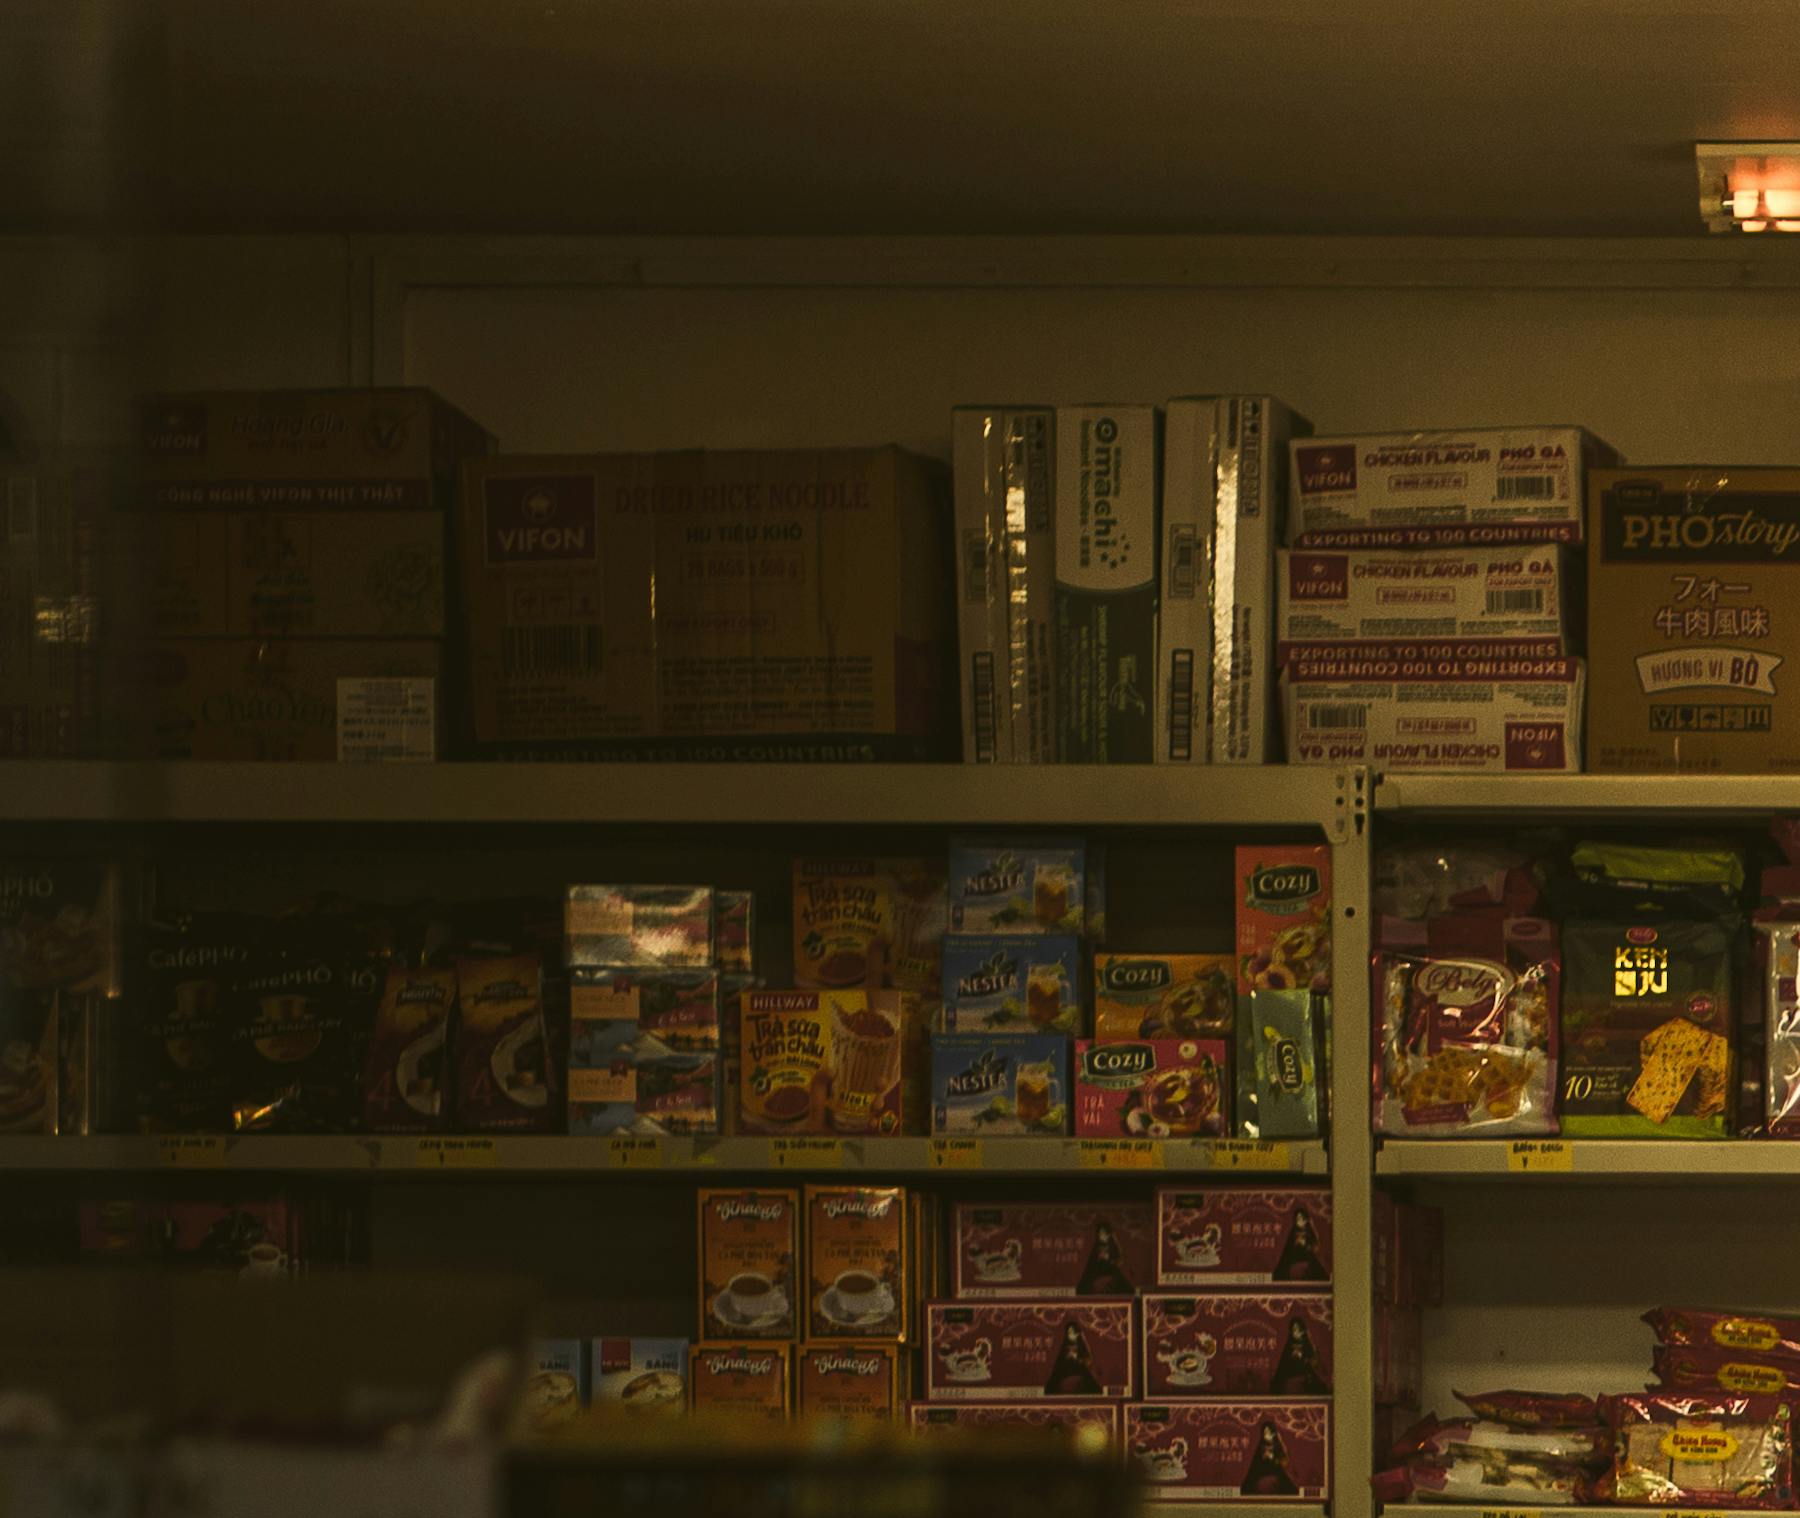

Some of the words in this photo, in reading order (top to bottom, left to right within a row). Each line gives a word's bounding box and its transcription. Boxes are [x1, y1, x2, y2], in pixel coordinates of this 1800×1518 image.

[1363, 451, 1424, 469] CHICKEN
[614, 483, 697, 515] DRIED
[701, 481, 762, 514] RICE
[768, 480, 870, 511] NOODLE
[497, 525, 587, 554] VIFON
[1302, 531, 1406, 547] EXPORTING
[1408, 529, 1431, 544] TO
[1435, 528, 1466, 543] 100
[1468, 526, 1571, 542] COUNTRIES
[1353, 563, 1411, 580] CHICKEN
[1674, 574, 1750, 601] フォー
[1656, 606, 1769, 637] 牛肉風味
[1289, 646, 1391, 662] EXPORTING
[1395, 646, 1418, 660] TO
[1422, 645, 1452, 660] 100
[1455, 643, 1558, 659] COUNTRIES
[1298, 661, 1400, 677] COUNTRIES
[1401, 662, 1434, 676] 100
[1437, 662, 1461, 675] TO
[1464, 660, 1568, 676] EXPORTING
[1258, 869, 1314, 898] Cozy
[1109, 963, 1164, 988] Cozy
[750, 994, 818, 1011] HILLWAY
[1091, 1049, 1148, 1074] Cozy
[1564, 1074, 1593, 1102] 10
